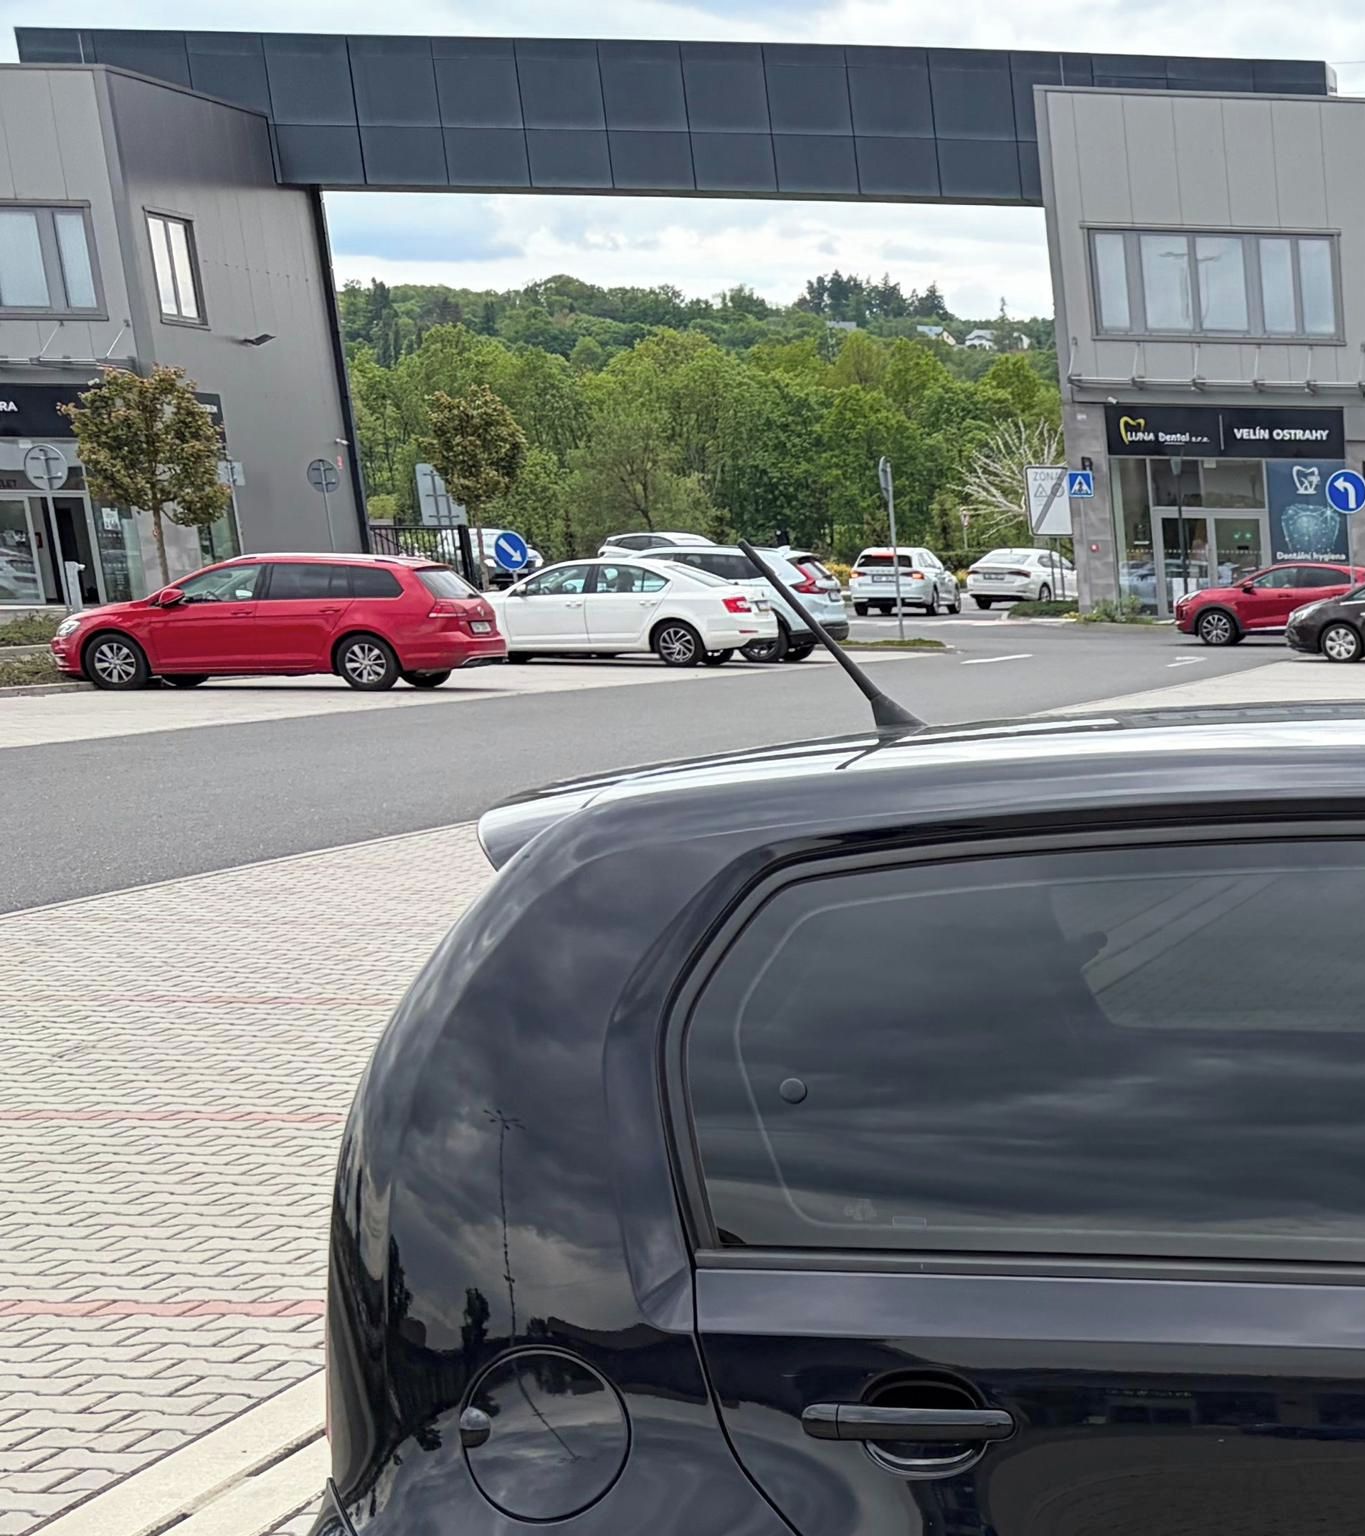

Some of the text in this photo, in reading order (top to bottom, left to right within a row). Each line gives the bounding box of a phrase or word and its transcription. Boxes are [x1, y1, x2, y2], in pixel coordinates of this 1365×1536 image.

[1127, 431, 1155, 441] LUNA
[1158, 432, 1190, 442] Dental
[1233, 426, 1330, 441] VELÍN OSTRAHY
